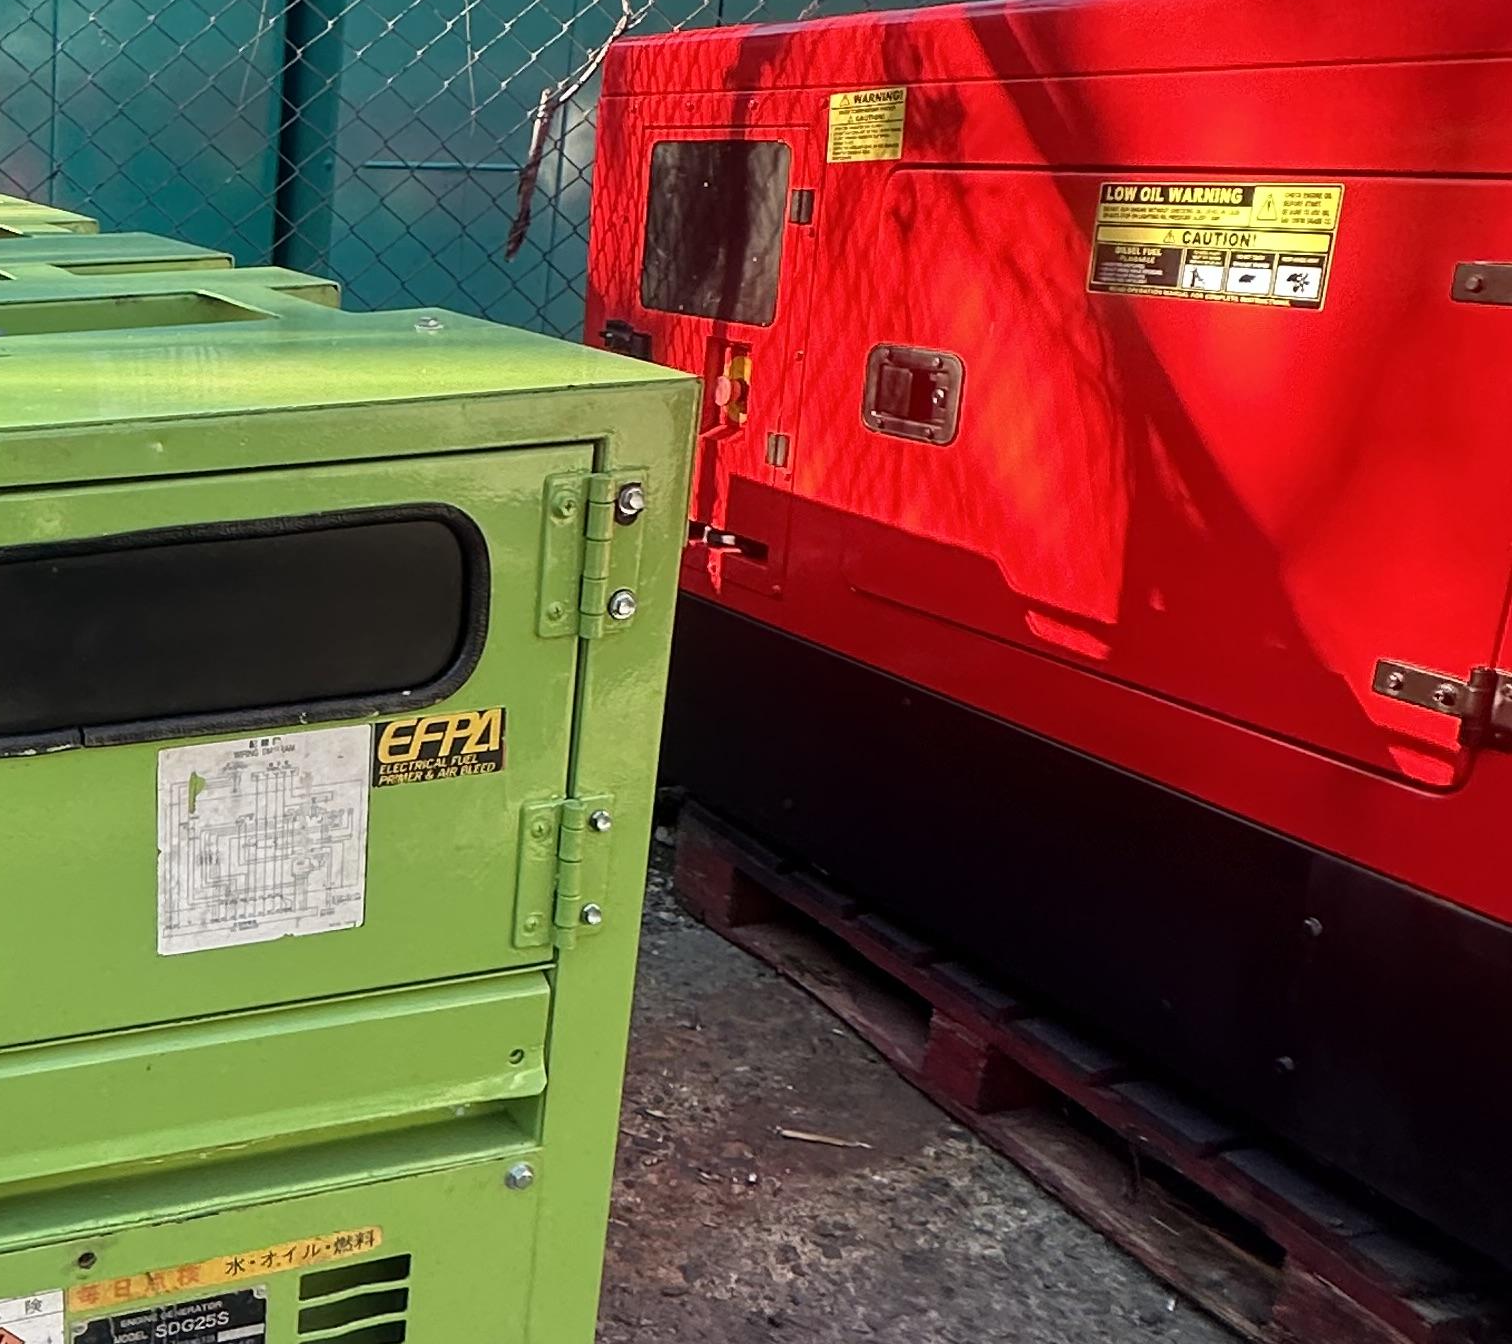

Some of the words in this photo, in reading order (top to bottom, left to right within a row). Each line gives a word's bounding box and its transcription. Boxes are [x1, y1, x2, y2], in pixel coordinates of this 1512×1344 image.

[1105, 186, 1138, 202] LOW
[1140, 187, 1164, 202] OIL
[1168, 188, 1243, 204] WARNING
[1181, 230, 1258, 247] CAUTION!
[380, 757, 447, 775] ELECTRICAL
[451, 754, 478, 765] FUEL
[437, 767, 457, 778] AIR
[155, 1311, 229, 1338] SDG25S
